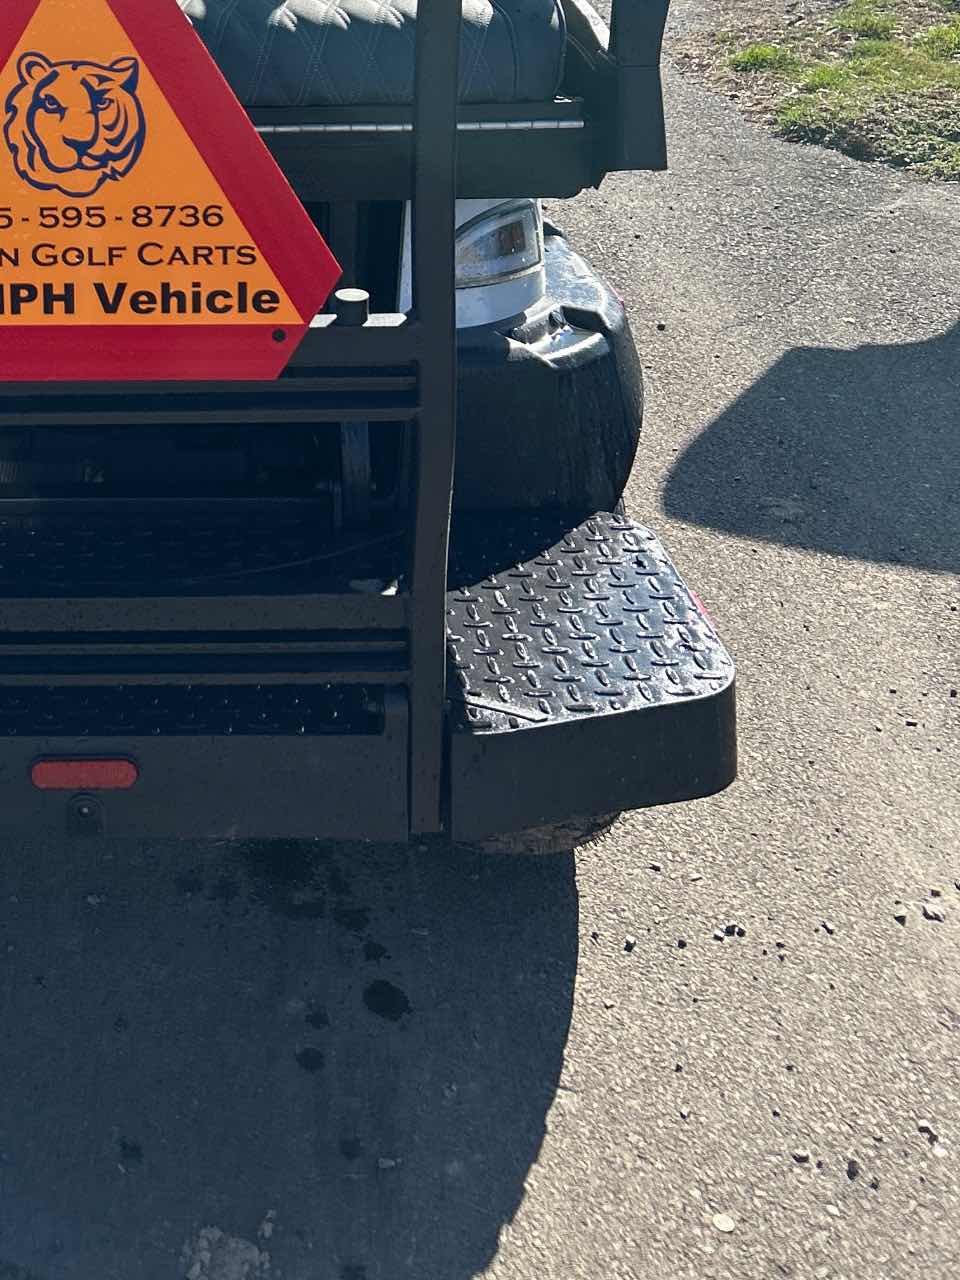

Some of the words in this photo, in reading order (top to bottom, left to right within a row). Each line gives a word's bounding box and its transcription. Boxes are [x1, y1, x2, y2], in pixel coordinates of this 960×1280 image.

[31, 243, 127, 267] GOLF
[137, 241, 257, 266] CARTS
[93, 281, 280, 314] Vehicle
